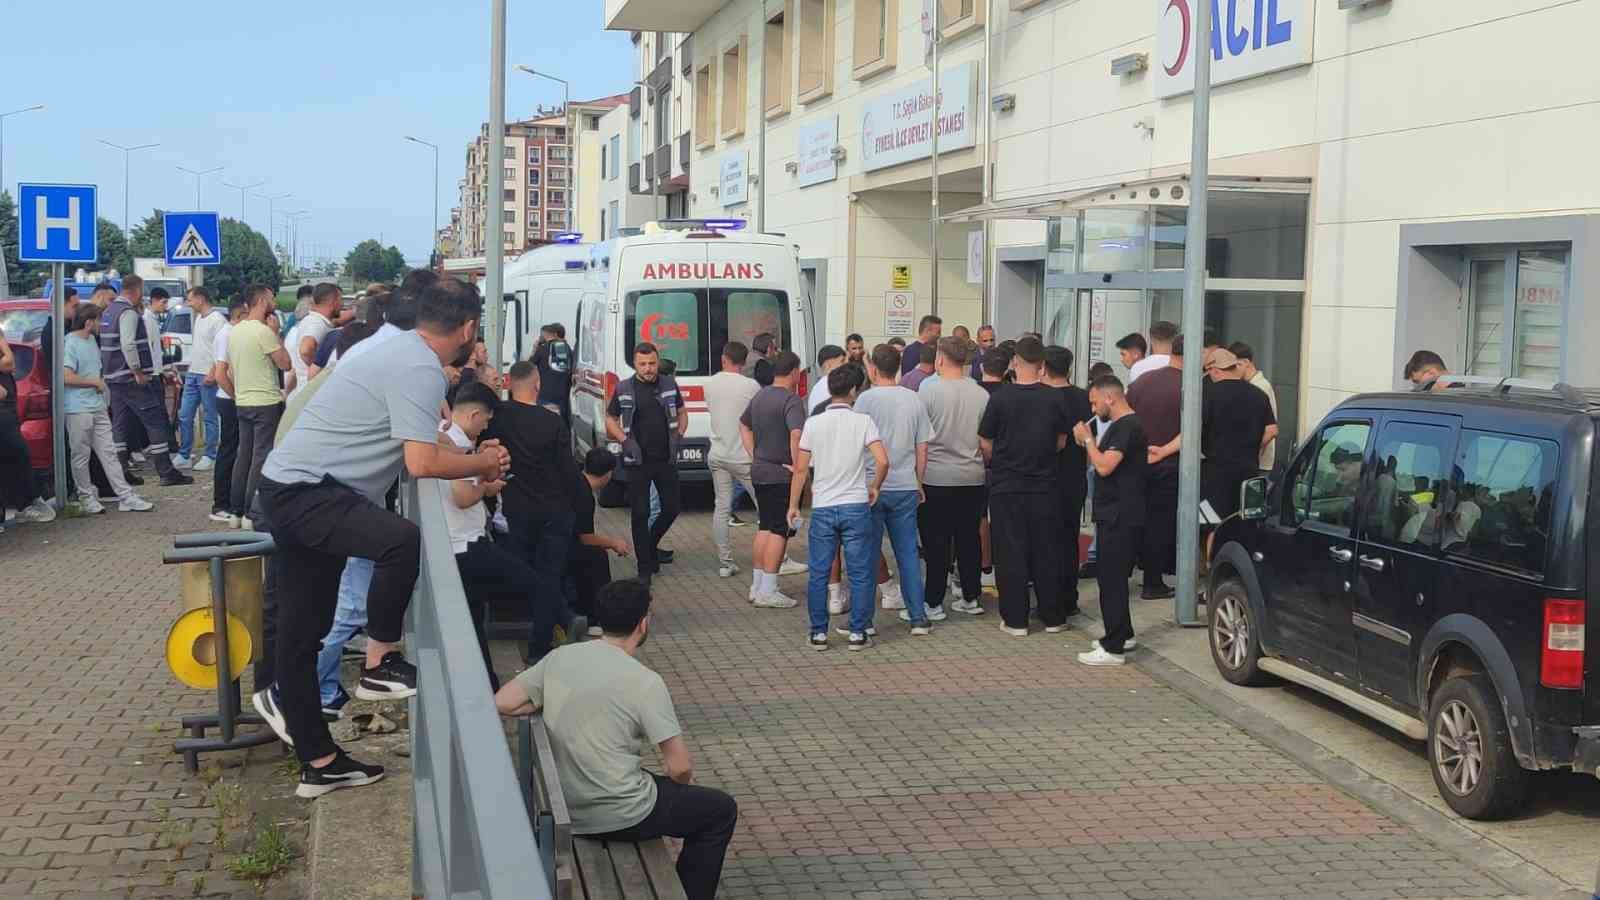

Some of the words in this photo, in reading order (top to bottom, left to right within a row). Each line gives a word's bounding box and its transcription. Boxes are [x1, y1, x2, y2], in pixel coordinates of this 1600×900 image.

[929, 106, 965, 138] HSTANESİ
[36, 196, 80, 251] H
[643, 263, 764, 280] AMBULANS
